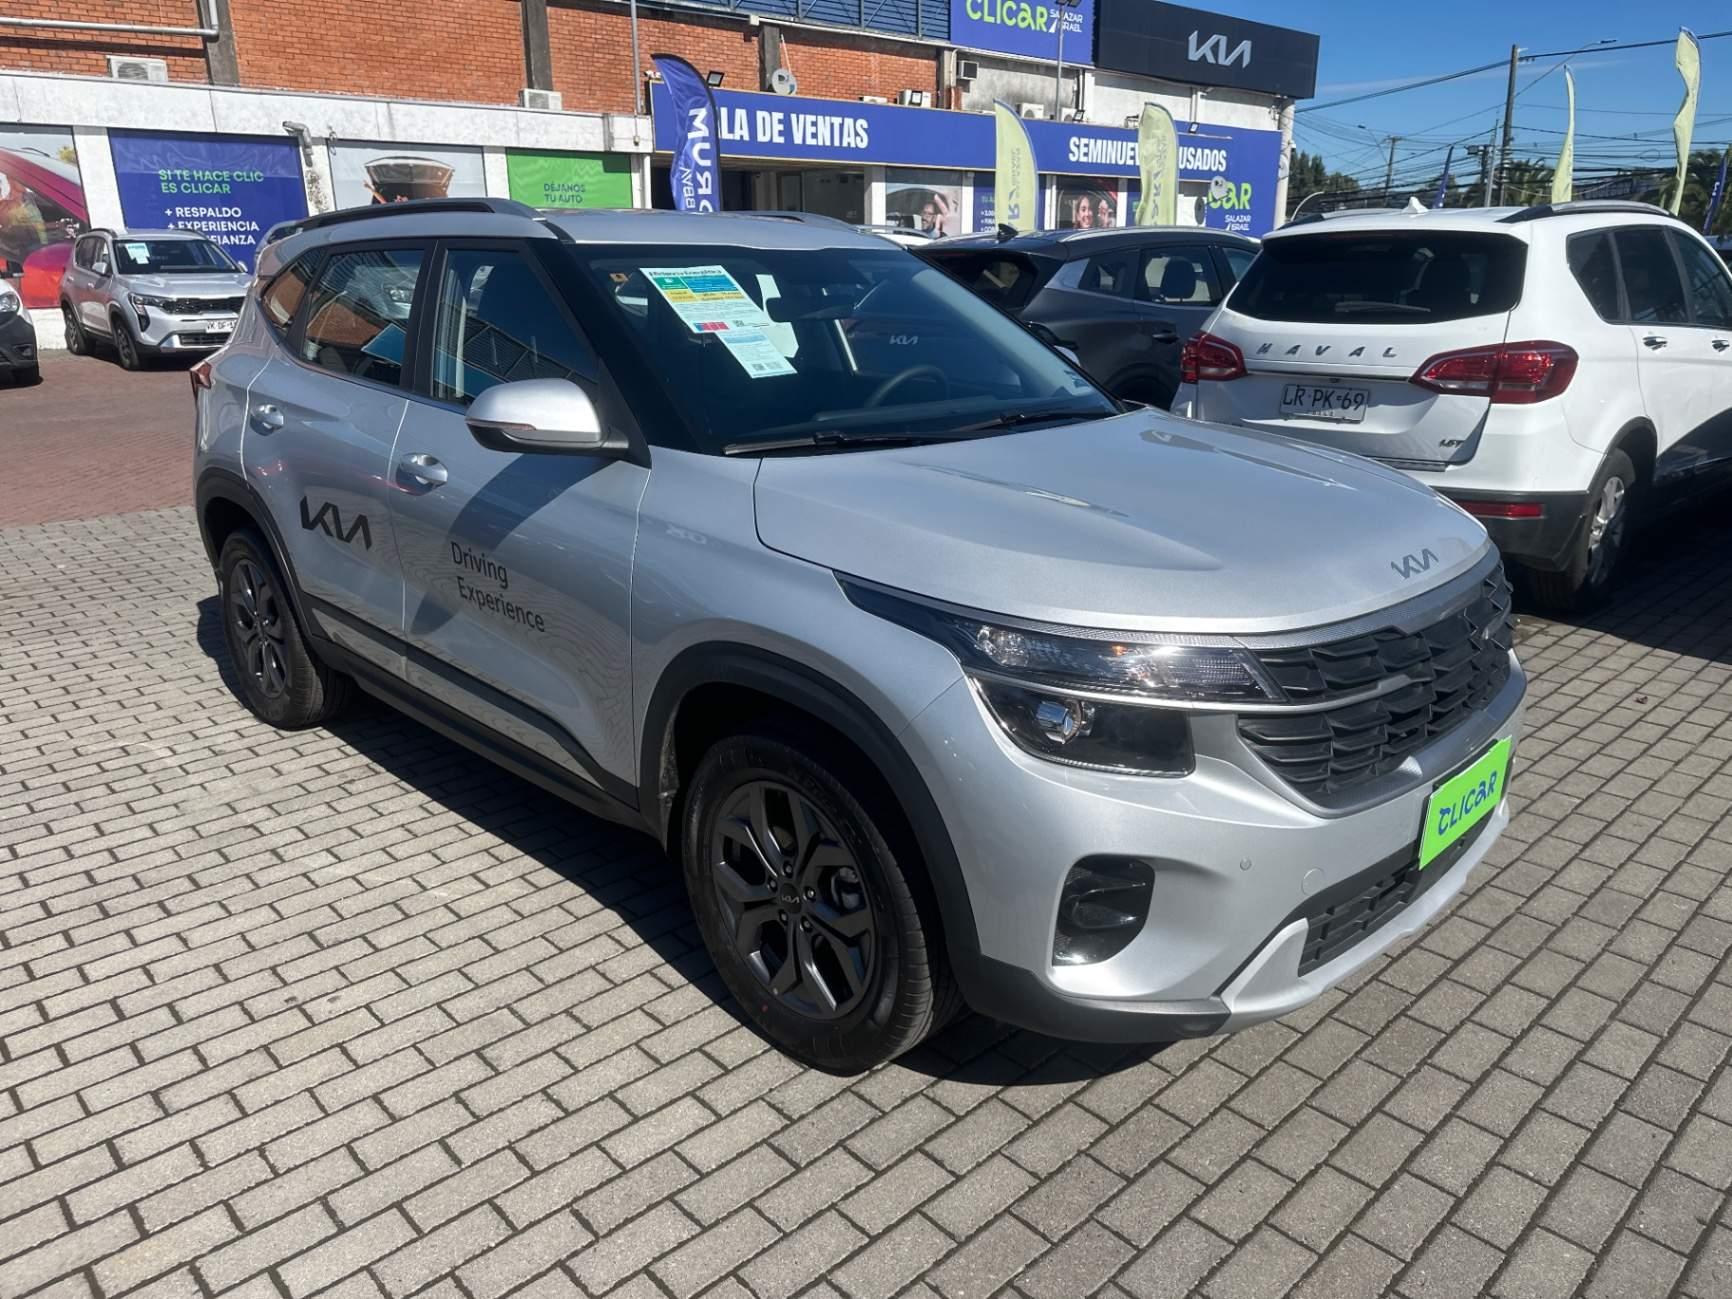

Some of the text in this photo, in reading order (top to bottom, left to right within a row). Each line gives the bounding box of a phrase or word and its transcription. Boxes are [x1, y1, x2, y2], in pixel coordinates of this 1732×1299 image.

[1050, 9, 1083, 24] SAAZAR
[1188, 30, 1252, 68] KIA
[756, 110, 785, 143] DE
[790, 113, 869, 149] VENTAS
[1178, 147, 1228, 172] USADOS
[159, 169, 264, 182] SI TE HACE CLIC
[161, 182, 231, 194] ES CLICAR
[544, 194, 584, 204] TU AUTO
[175, 207, 242, 218] RESPALDO
[177, 221, 260, 231] EXPERIENCIA
[208, 234, 256, 245] FIANZA
[1256, 343, 1397, 358] HAVAL
[300, 495, 372, 551] KIA
[450, 541, 508, 590] Driving
[1391, 548, 1439, 581] KIA
[456, 576, 545, 633] Experience
